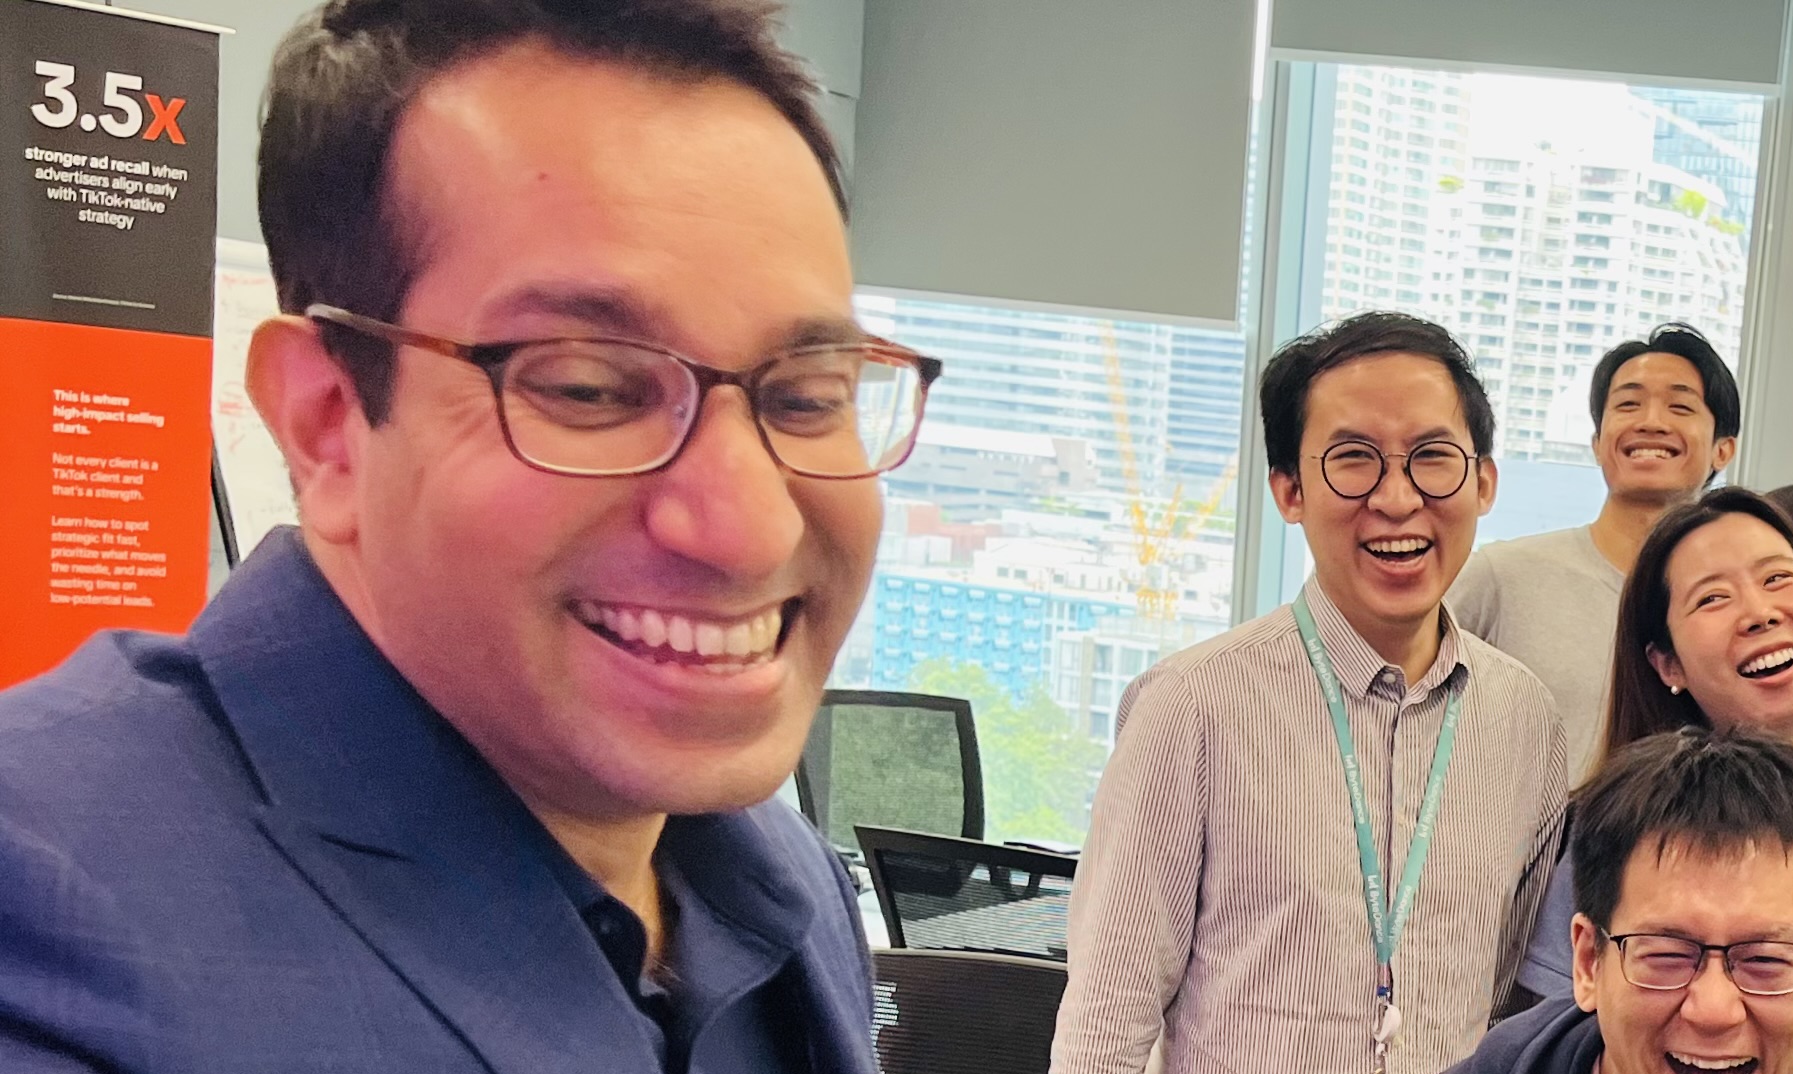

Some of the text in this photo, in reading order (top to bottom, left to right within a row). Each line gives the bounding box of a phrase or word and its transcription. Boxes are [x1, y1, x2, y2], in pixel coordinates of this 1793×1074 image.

[30, 60, 187, 145] 3.5x
[25, 146, 188, 181] stronger ad recall when
[35, 166, 178, 200] advertisers align early
[47, 186, 166, 214] with TikTok-native
[78, 208, 135, 230] strategy
[53, 389, 130, 407] This is where
[53, 405, 165, 428] high-impact selling
[53, 422, 91, 435] starts.
[52, 452, 159, 471] Not every client is a
[52, 468, 144, 485] TikTok client and
[85, 488, 94, 498] a
[51, 515, 149, 532] Learn how to spot
[51, 531, 140, 547] strategic fit fast,
[51, 547, 166, 563] prioritize what moves
[1313, 651, 1337, 703] ByteDance
[1349, 769, 1365, 825] ByteDance
[1370, 890, 1383, 944] ByteDance
